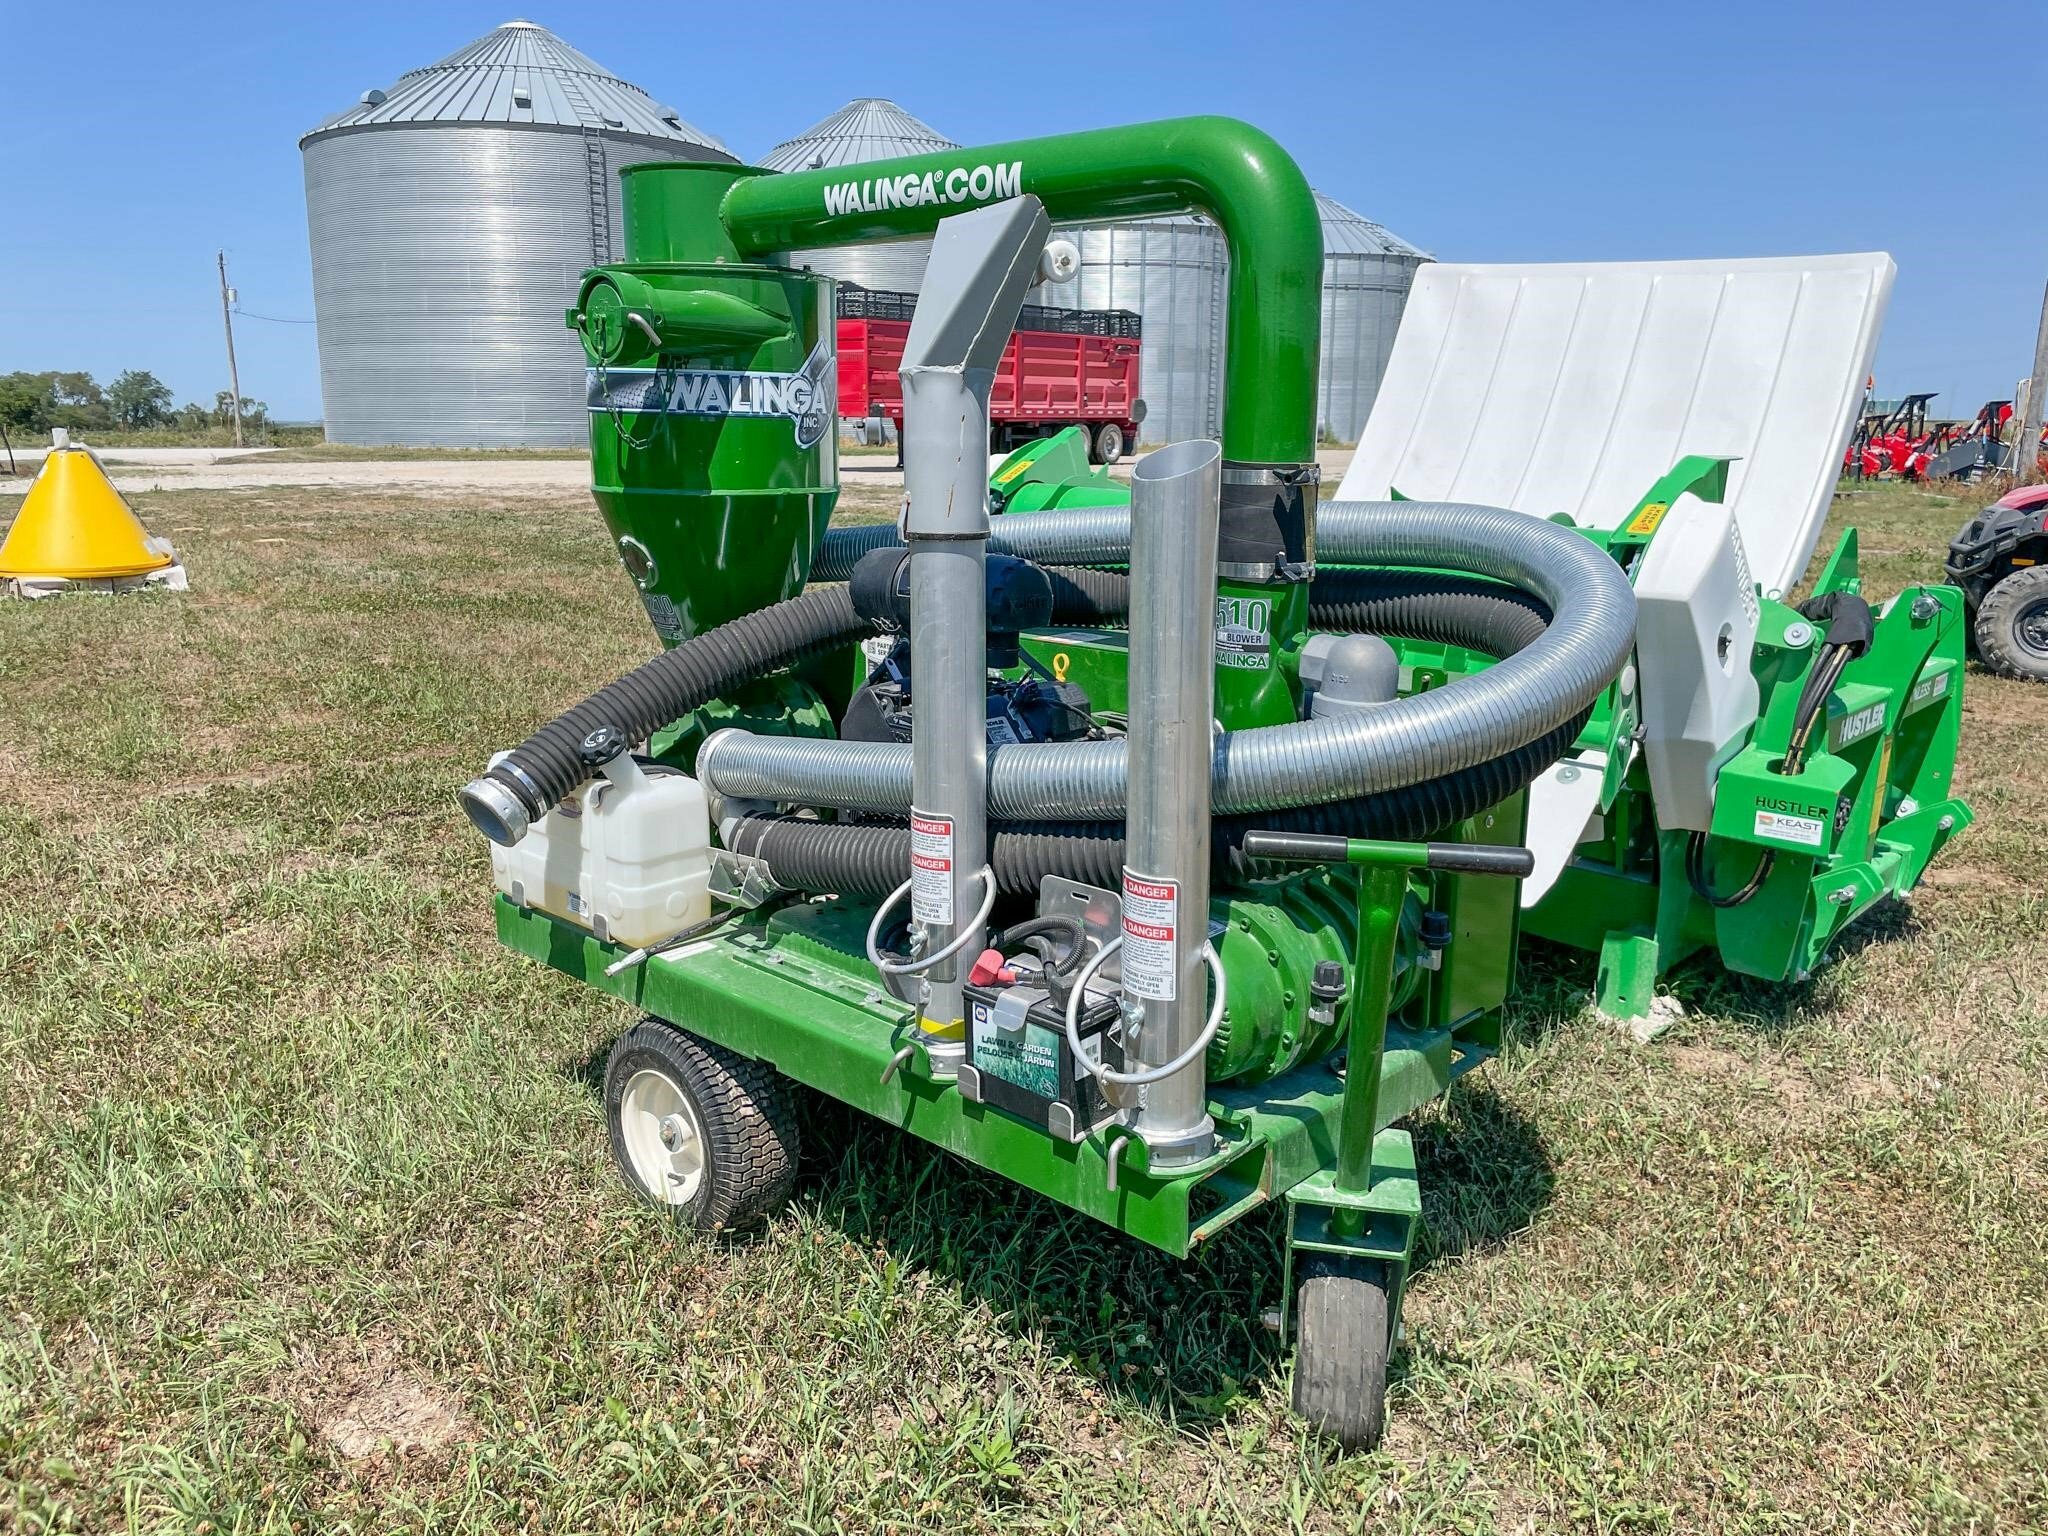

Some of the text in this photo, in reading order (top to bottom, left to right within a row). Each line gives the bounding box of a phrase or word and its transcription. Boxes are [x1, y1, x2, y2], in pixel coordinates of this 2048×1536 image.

[656, 374, 828, 414] WALINGA
[803, 416, 821, 429] INC.
[1216, 597, 1268, 636] 510
[1226, 633, 1262, 644] BLOWER
[1839, 702, 1887, 744] HUSTLER
[1755, 795, 1829, 820] HUSTLER
[913, 820, 946, 834] DANGER
[1777, 817, 1821, 831] KEAST
[913, 856, 946, 870] DANGER
[1128, 881, 1169, 899] DANGER
[1128, 921, 1168, 939] DANGER
[981, 1034, 1052, 1056] LAWN & GARDEN
[977, 1045, 1014, 1060] PELOUSE
[1023, 1055, 1055, 1068] JARDIN
